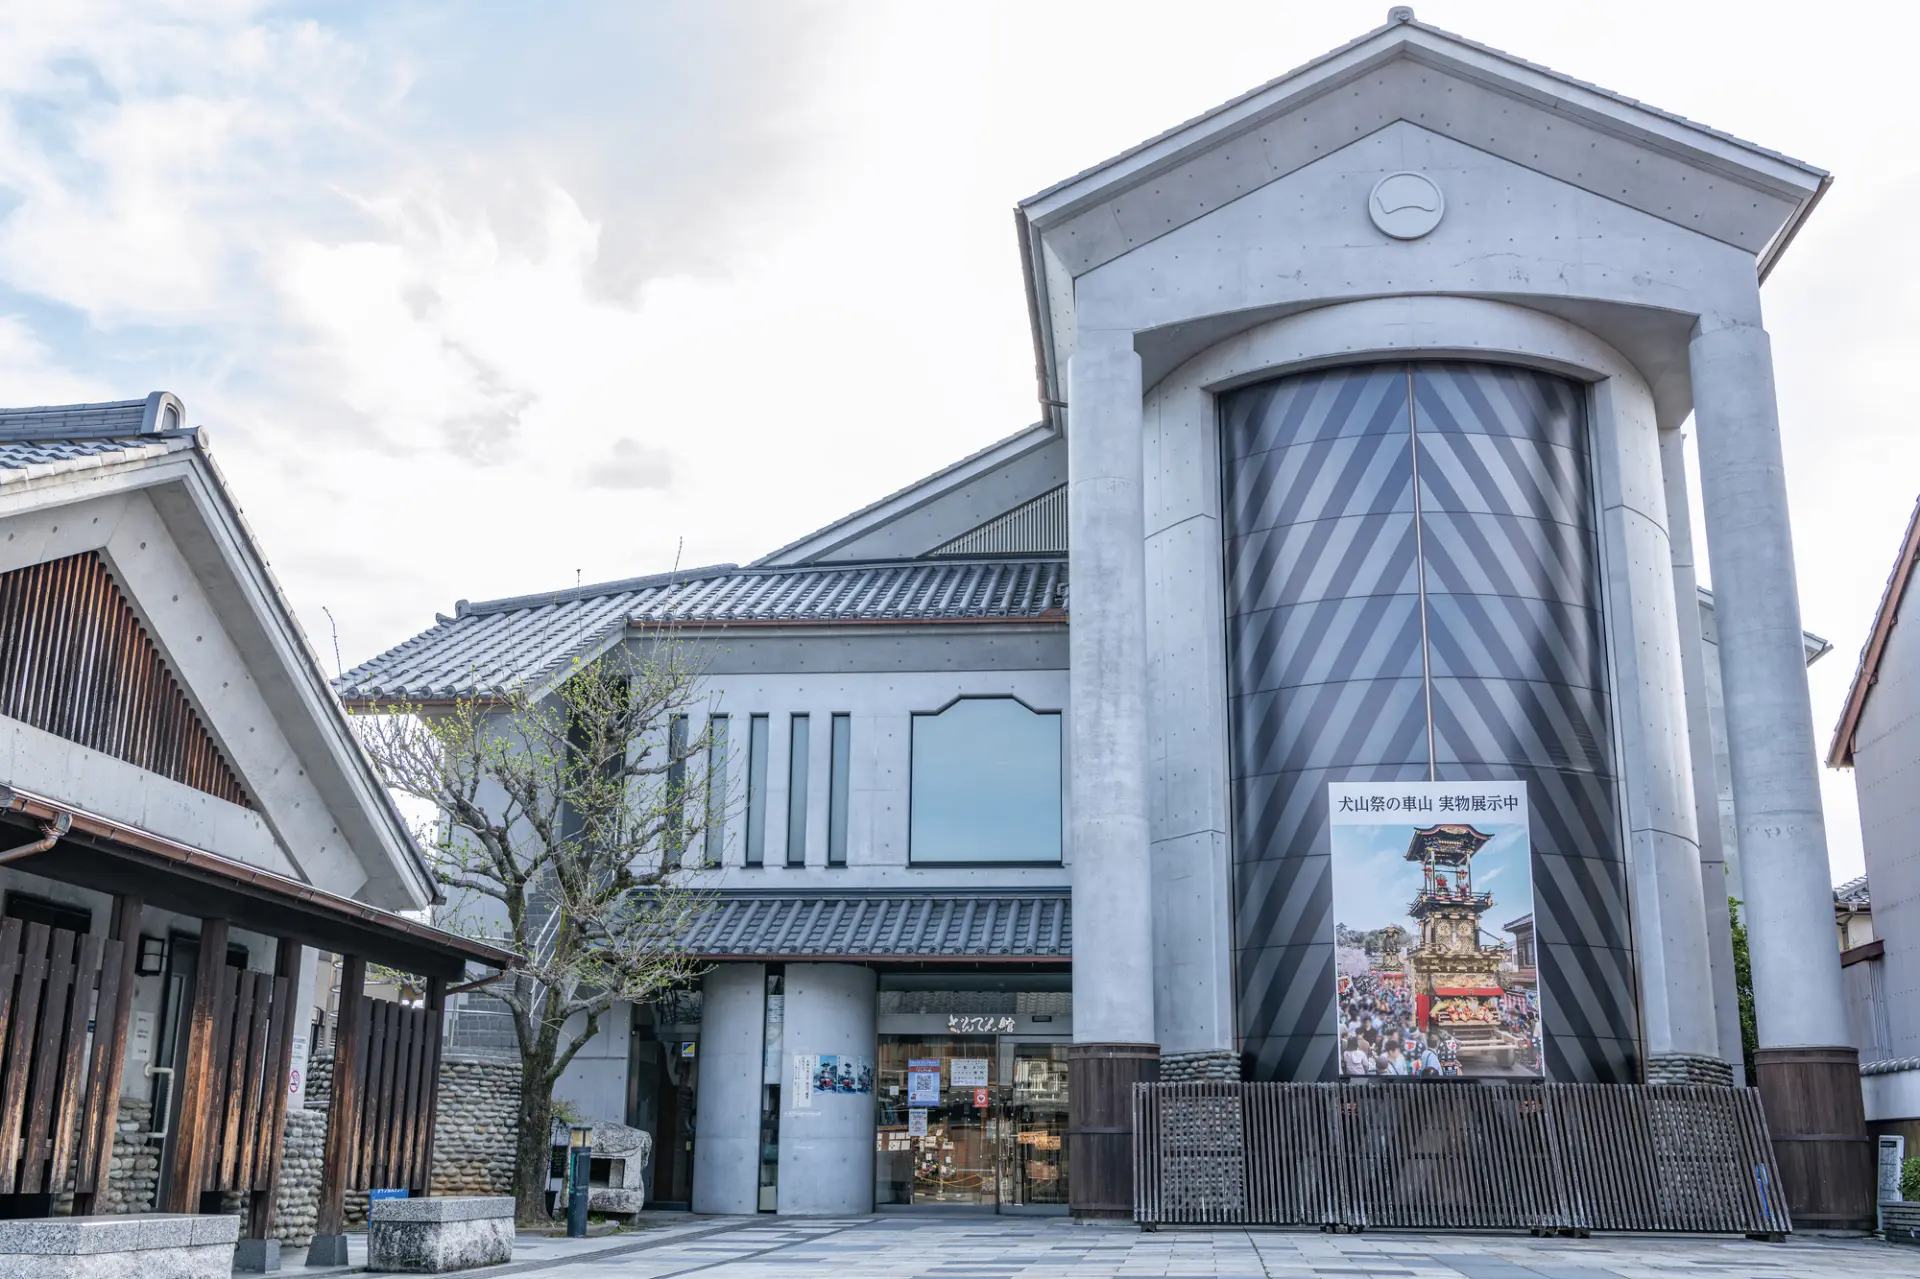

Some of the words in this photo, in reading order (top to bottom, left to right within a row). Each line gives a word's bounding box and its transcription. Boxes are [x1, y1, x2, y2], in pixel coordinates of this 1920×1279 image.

[1338, 795, 1433, 812] 犬山祭の車山
[1438, 795, 1518, 812] 実物展示中
[948, 1014, 1016, 1034] どんでん館
